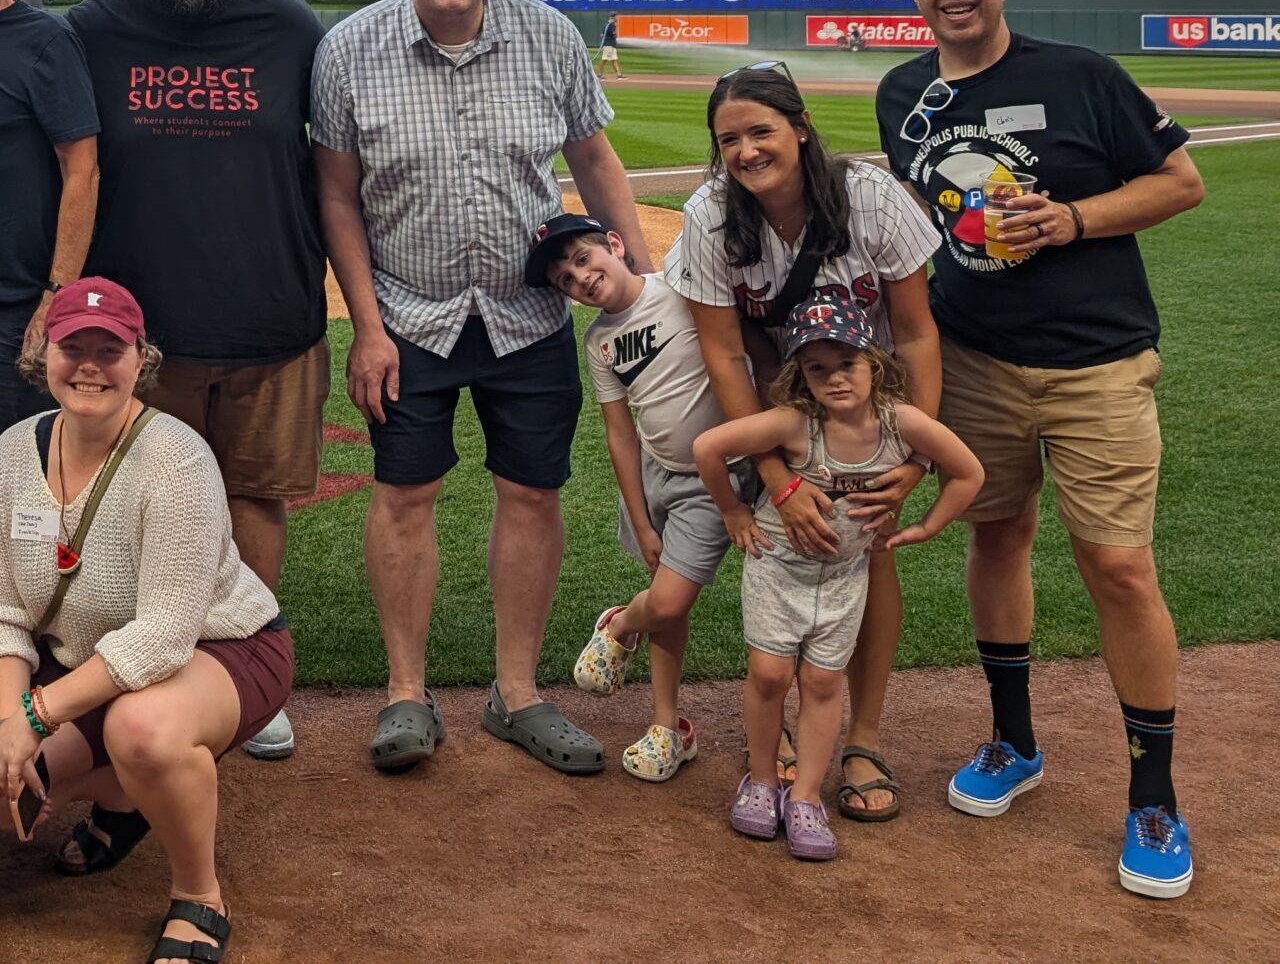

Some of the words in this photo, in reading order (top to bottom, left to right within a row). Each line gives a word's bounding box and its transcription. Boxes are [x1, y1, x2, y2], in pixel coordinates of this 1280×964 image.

[649, 22, 714, 40] Paycor
[1172, 23, 1205, 40] us
[130, 65, 255, 89] PROJECT
[128, 89, 259, 111] SUCCESS
[134, 116, 164, 126] Where
[167, 117, 209, 126] students
[213, 119, 252, 128] connect
[152, 127, 163, 135] to
[165, 127, 189, 136] their
[192, 128, 232, 139] purpose
[909, 128, 953, 182] MINNEAPOLIS
[953, 125, 989, 139] PUBLIC
[990, 133, 1039, 167] SCHOOLS
[969, 257, 1006, 272] INDIAN
[614, 323, 657, 366] NIKE
